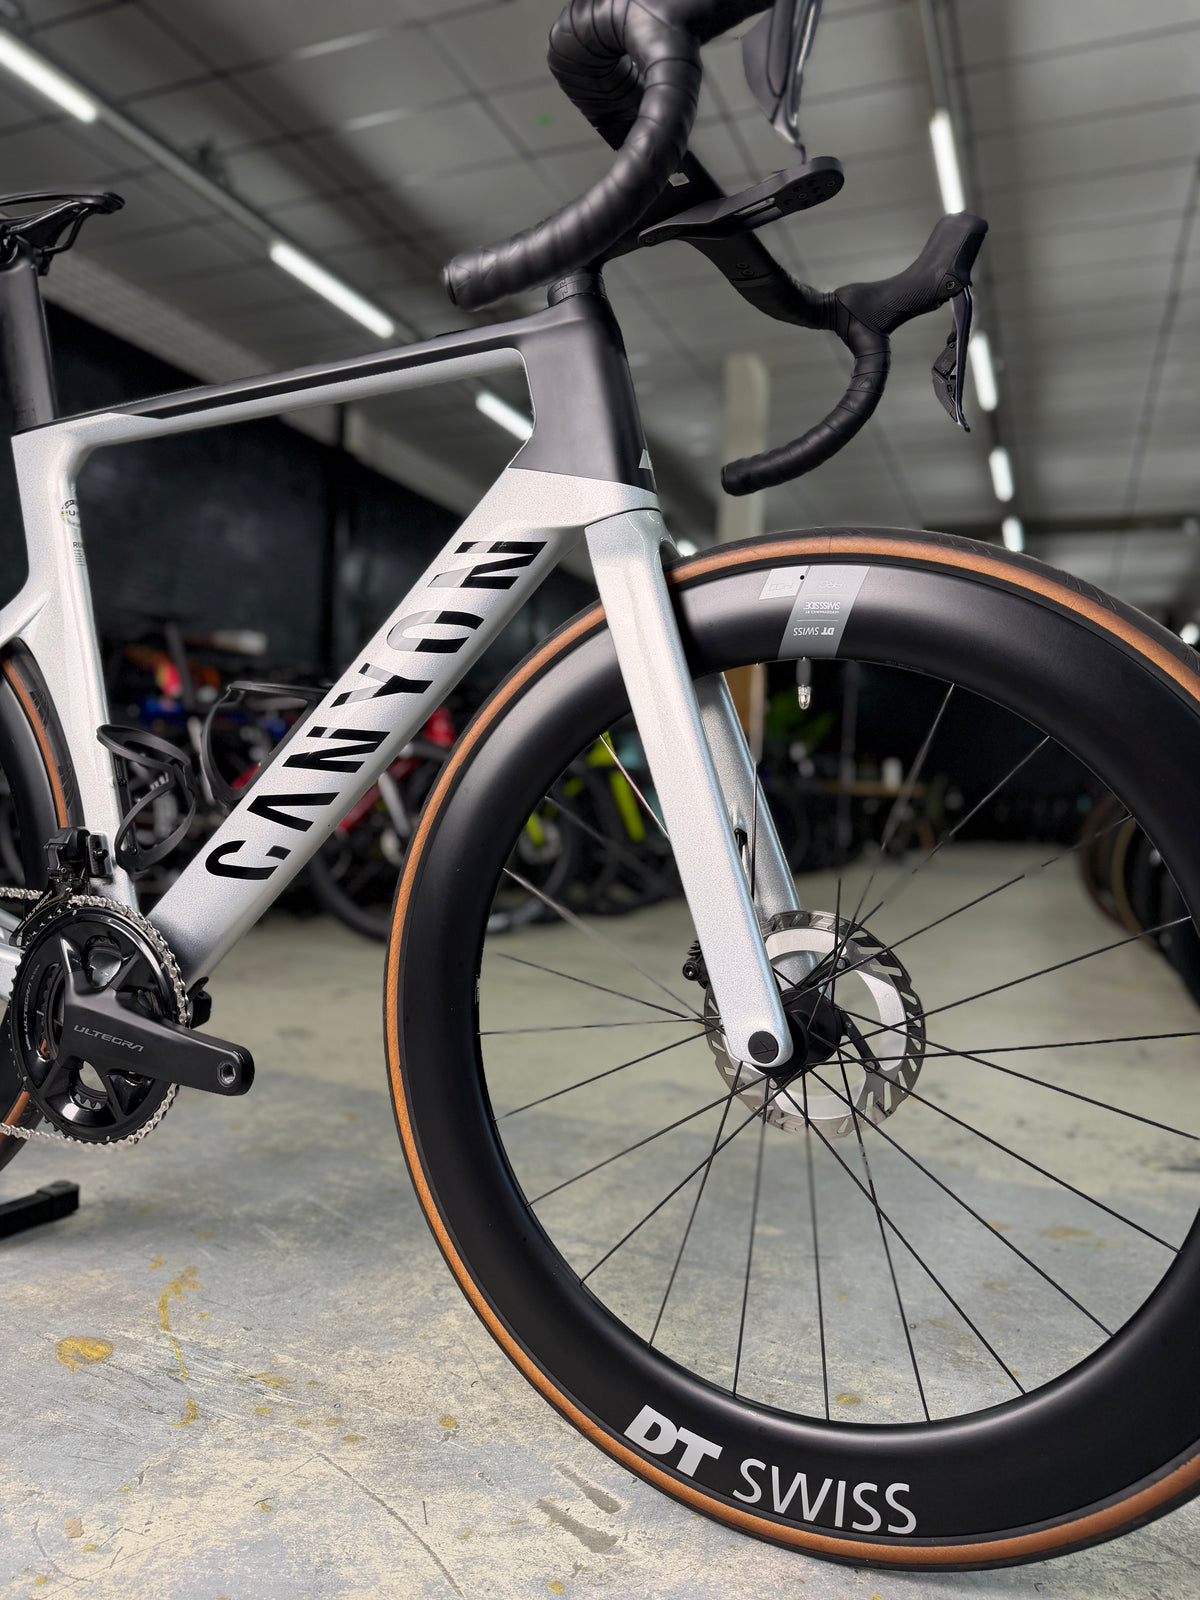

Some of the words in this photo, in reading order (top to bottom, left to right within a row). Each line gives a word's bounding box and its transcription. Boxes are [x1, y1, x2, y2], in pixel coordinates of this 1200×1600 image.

[793, 627, 820, 636] SWISS
[820, 627, 835, 636] DT
[205, 541, 548, 880] CANYON
[73, 1024, 145, 1052] ULTEGRA
[623, 1404, 723, 1478] DT
[732, 1458, 917, 1535] SWISS
